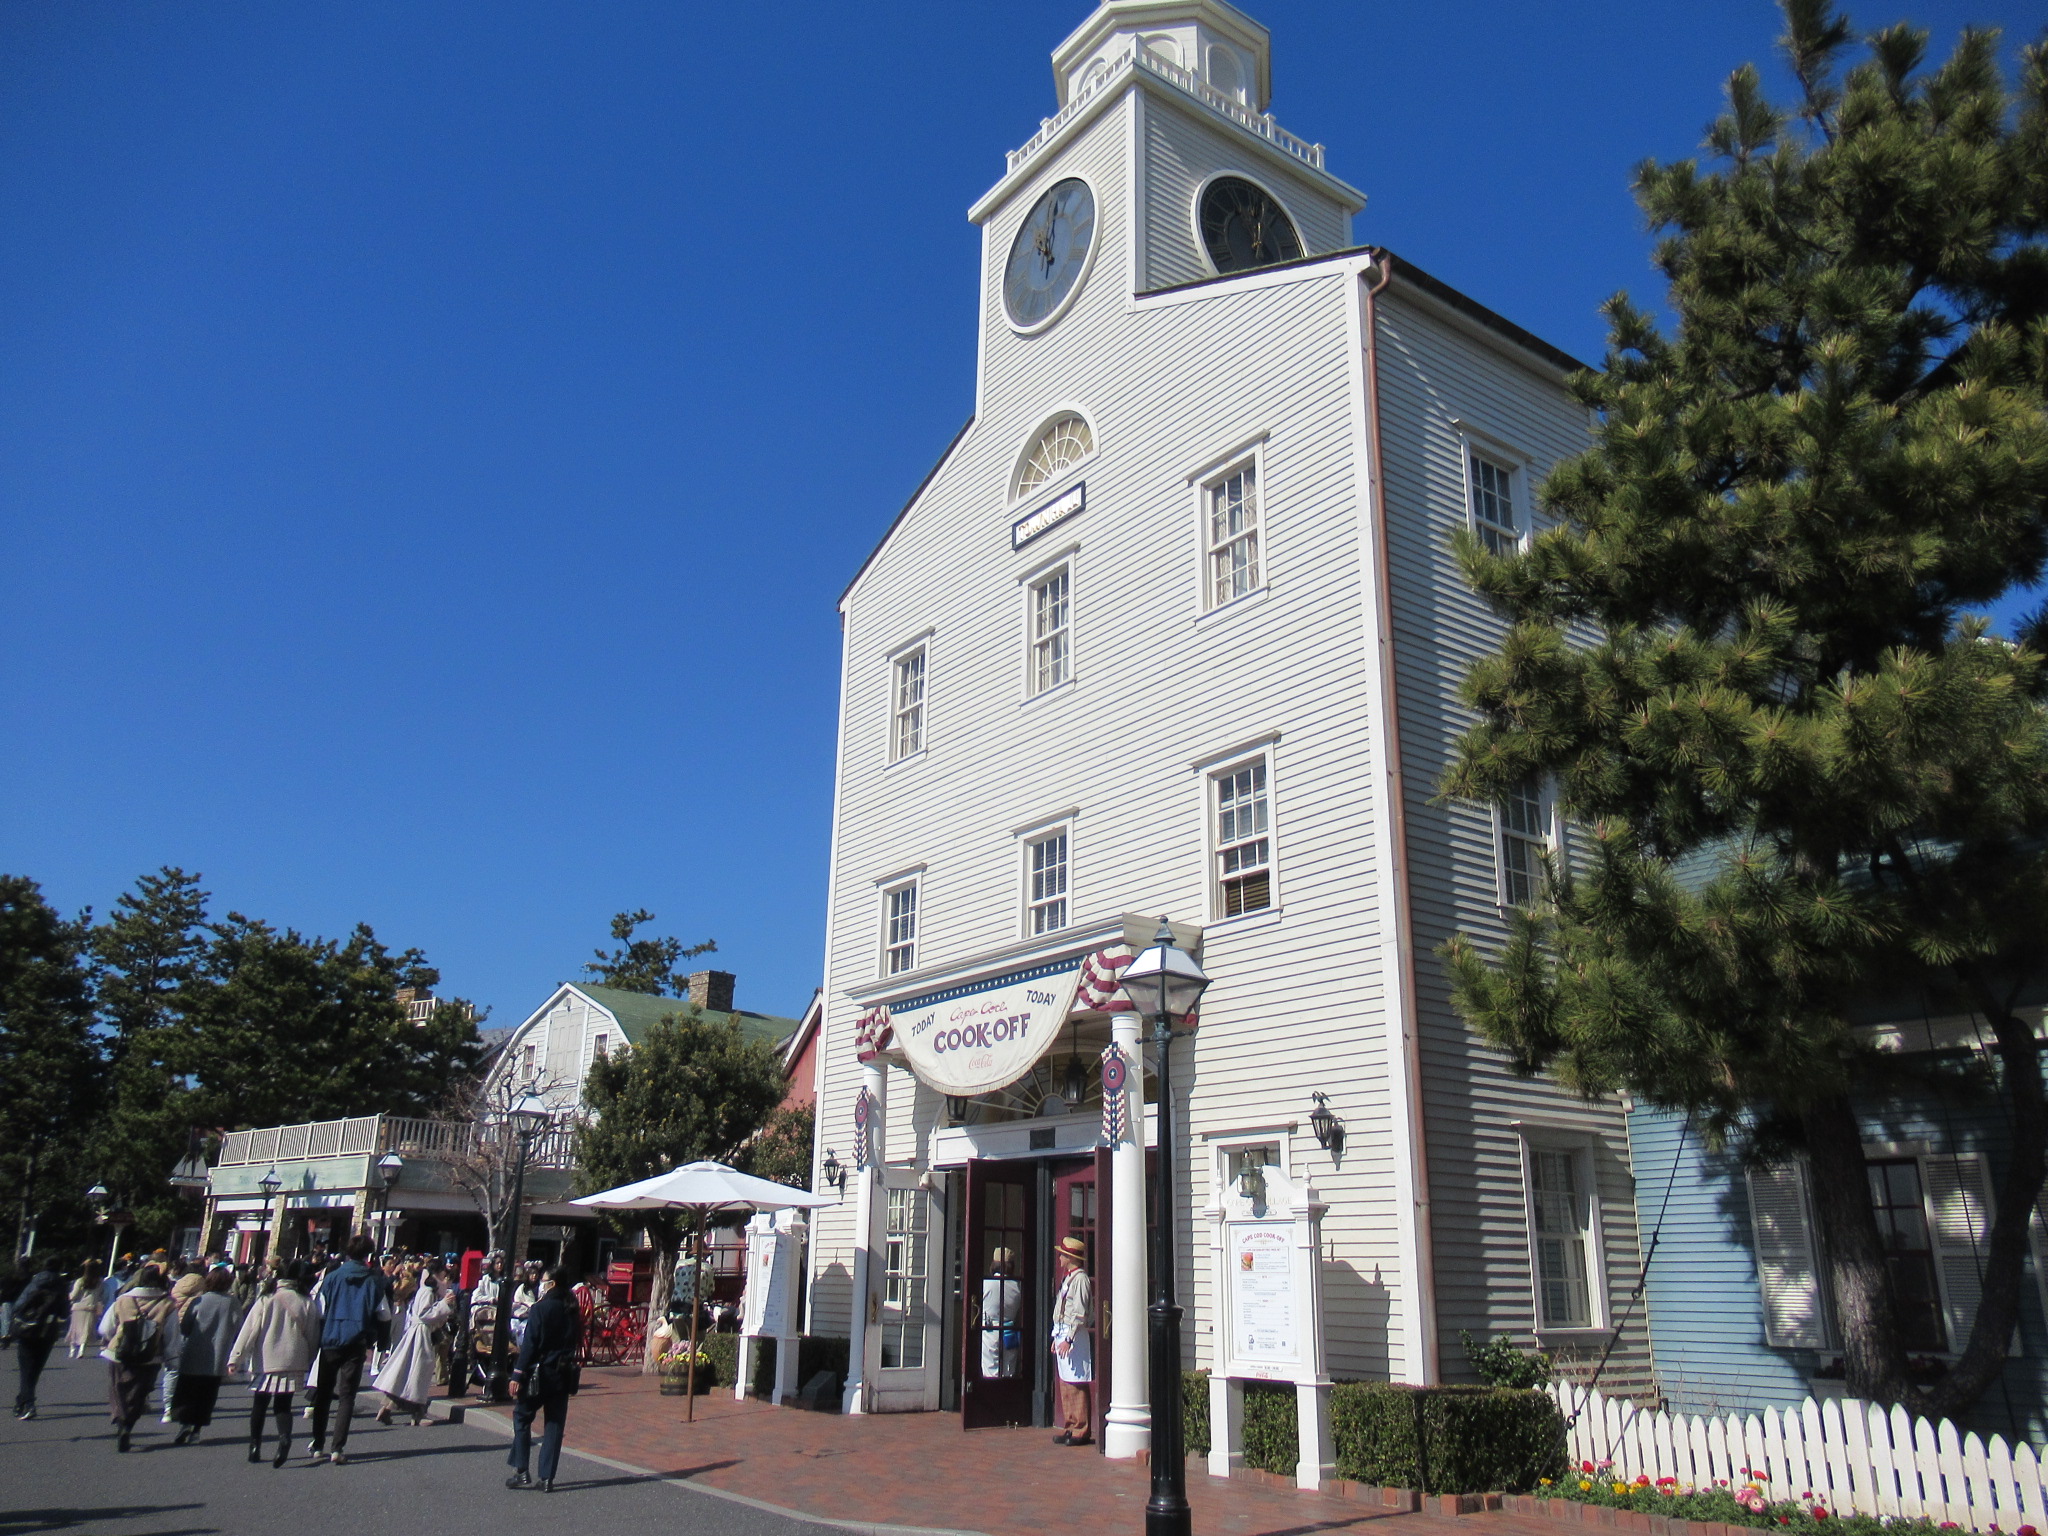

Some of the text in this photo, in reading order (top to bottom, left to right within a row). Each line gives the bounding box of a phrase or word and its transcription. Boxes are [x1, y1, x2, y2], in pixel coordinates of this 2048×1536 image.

[1026, 989, 1057, 1006] TODAY
[911, 1011, 936, 1037] TODAY
[950, 1001, 1008, 1026] Cape Cod
[933, 1012, 1031, 1054] COOK-OFF
